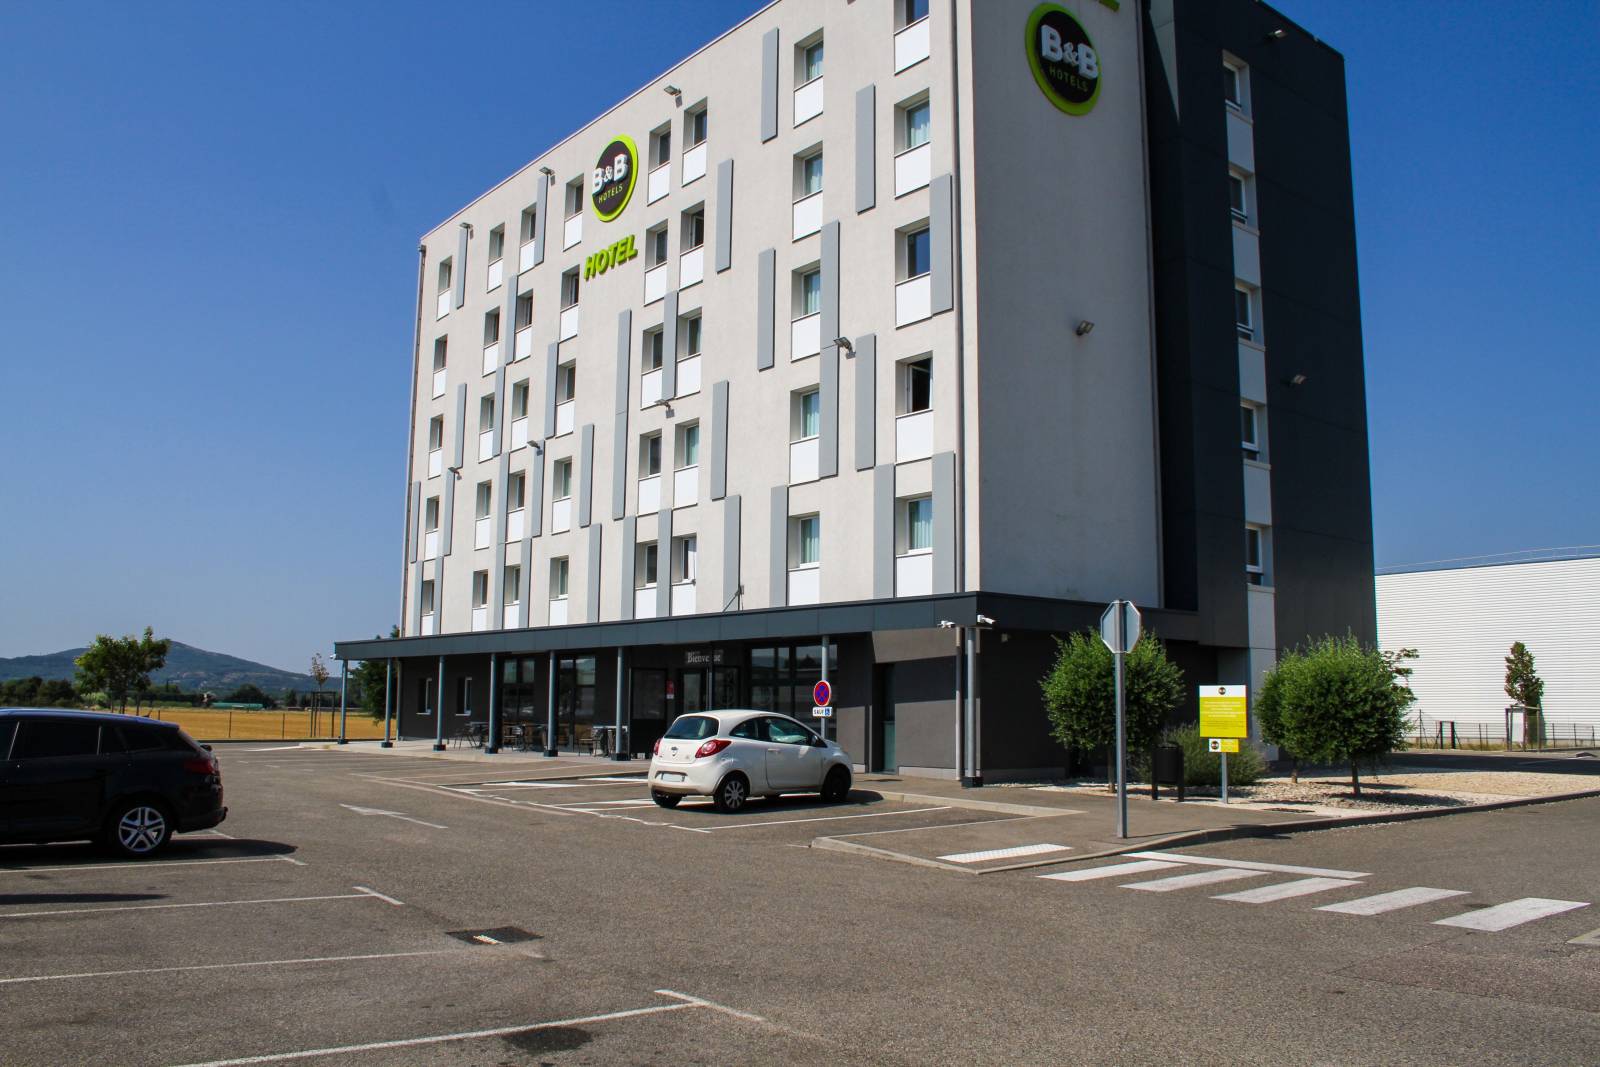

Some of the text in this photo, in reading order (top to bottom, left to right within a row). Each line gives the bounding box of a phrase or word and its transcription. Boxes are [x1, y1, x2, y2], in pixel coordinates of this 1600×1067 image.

[1041, 24, 1098, 79] B&B
[1049, 65, 1089, 92] HOTELS
[592, 153, 628, 195] B&B
[598, 183, 624, 203] HOTELS
[584, 234, 638, 282] HOTEL
